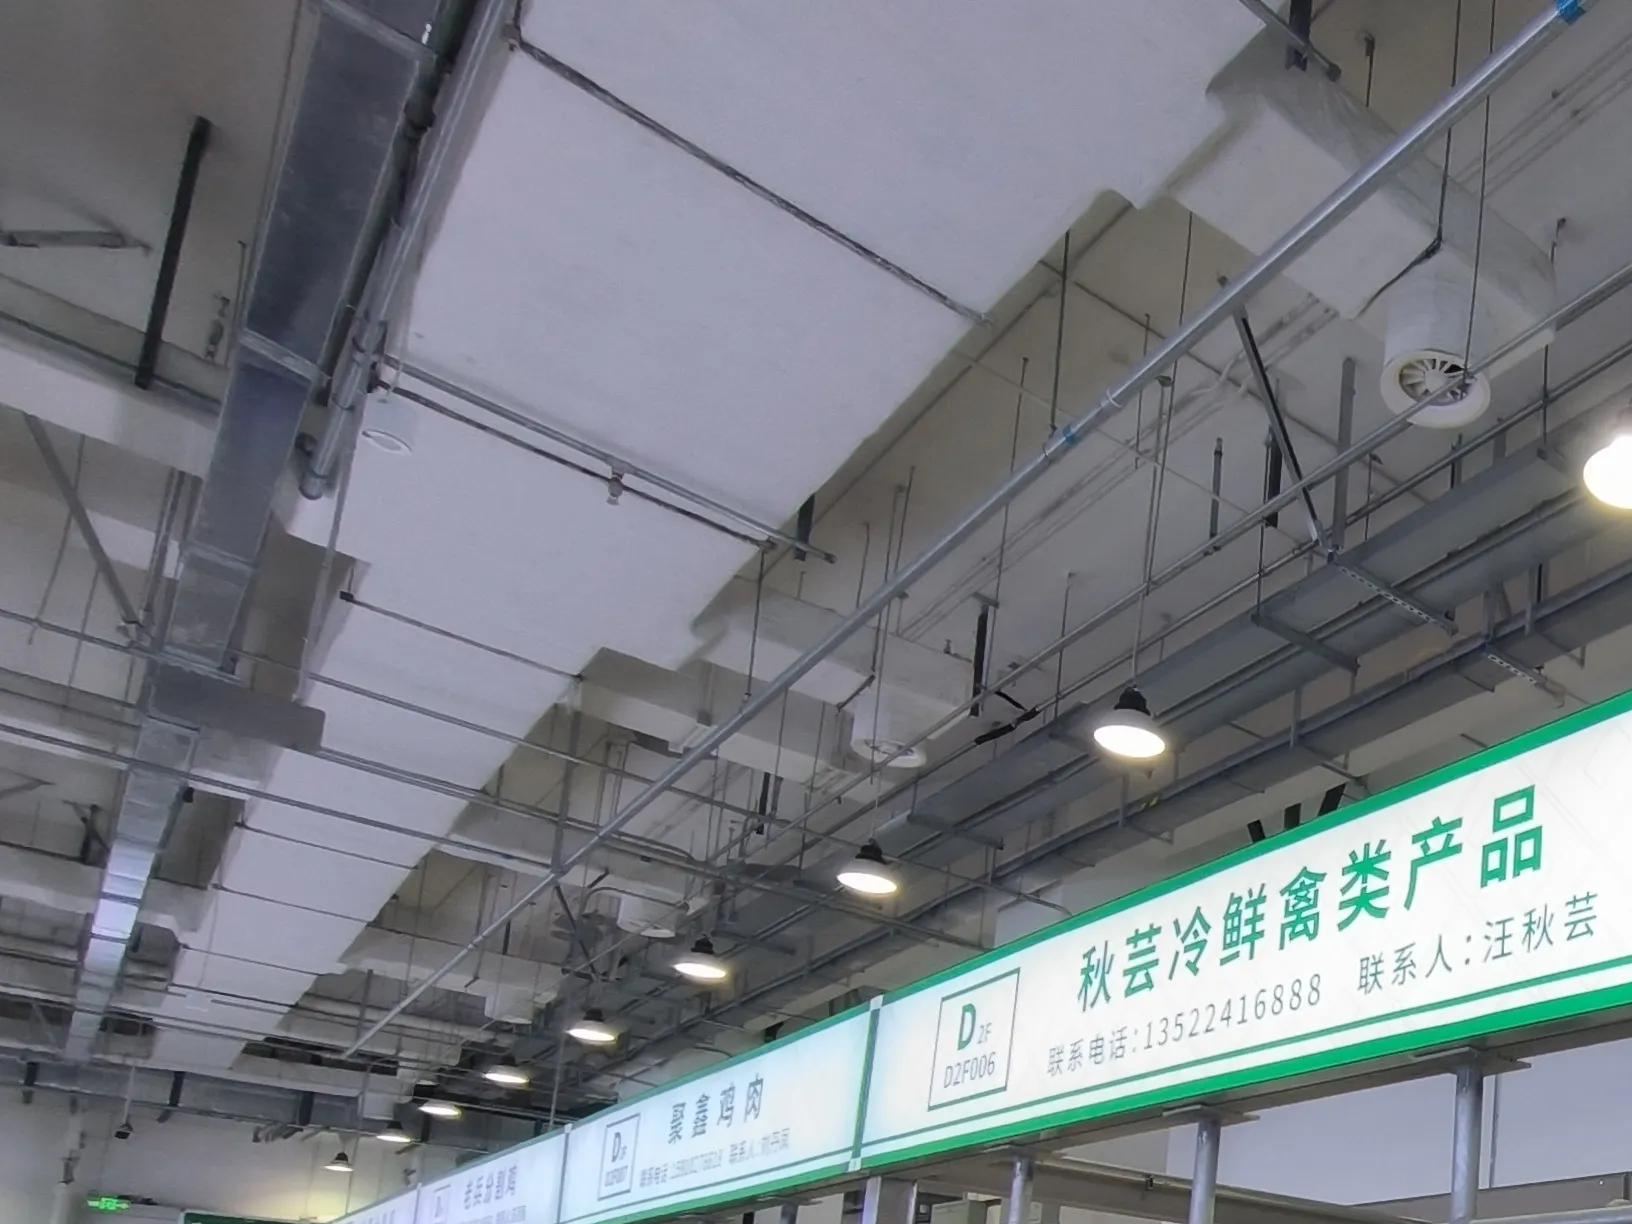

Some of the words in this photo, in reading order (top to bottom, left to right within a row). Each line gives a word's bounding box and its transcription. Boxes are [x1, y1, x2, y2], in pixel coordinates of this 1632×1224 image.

[1076, 784, 1544, 1013] 秋芸冷鲜禽类产品
[1357, 891, 1600, 996] 联系人:汪秋芸
[956, 1003, 977, 1051] D
[943, 1051, 996, 1089] D2F006
